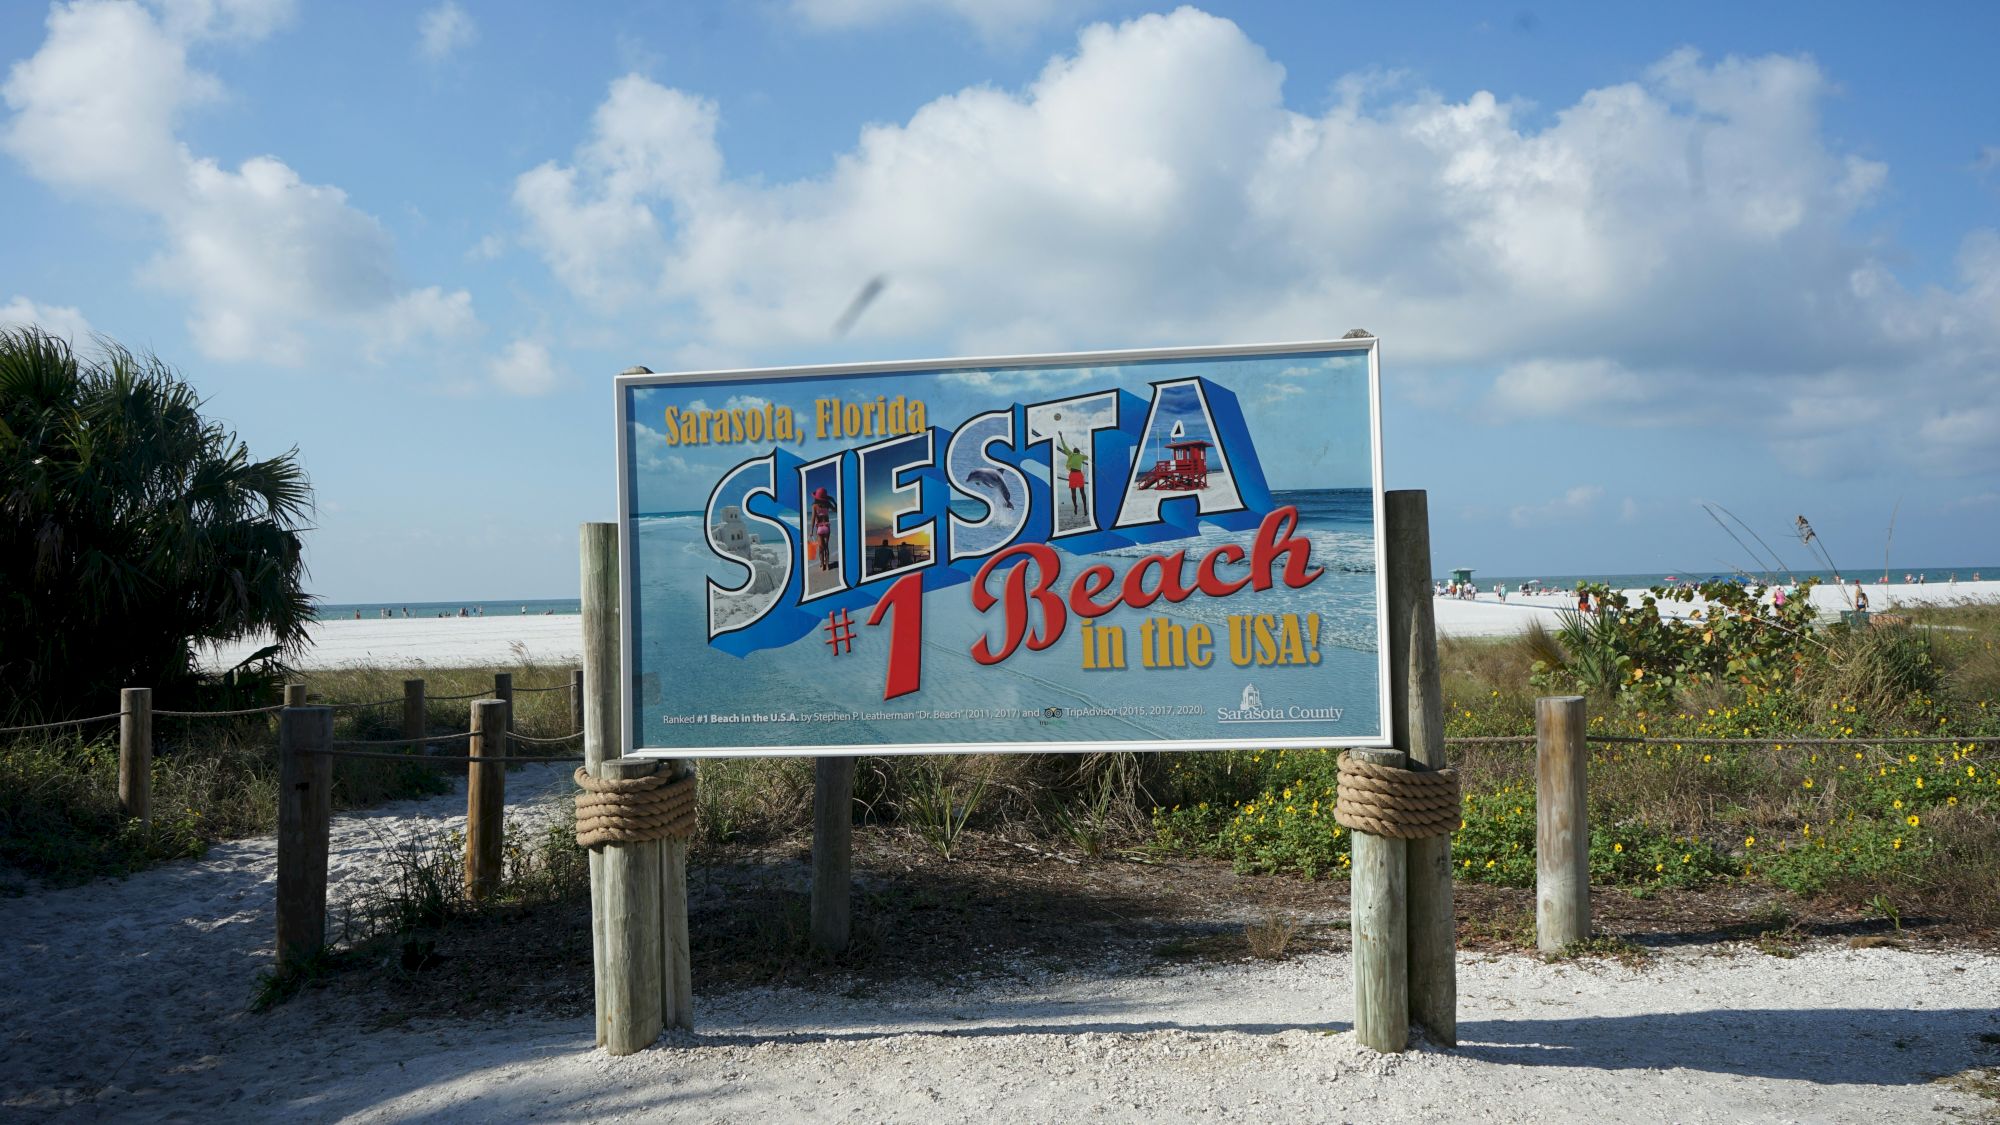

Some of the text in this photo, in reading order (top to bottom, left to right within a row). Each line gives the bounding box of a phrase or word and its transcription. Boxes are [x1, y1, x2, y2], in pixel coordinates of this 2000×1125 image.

[665, 395, 927, 446] Sarasota, Florida
[704, 376, 1248, 644] SIESTA
[824, 505, 1325, 700] #1 Beach
[1081, 612, 1323, 670] in the USA!
[663, 714, 695, 724] Ranked
[697, 714, 708, 724] #1
[710, 713, 740, 723] Beach
[741, 713, 750, 723] in
[752, 713, 769, 723] the
[770, 712, 799, 722] U.S.A.
[801, 712, 812, 724] by
[813, 711, 851, 724] Stephen
[861, 710, 915, 721] Leatherman
[965, 708, 993, 721] (2011,
[995, 708, 1021, 720] 2017)
[1022, 708, 1040, 718] and
[1065, 706, 1118, 719] TripAdvisor
[1119, 705, 1148, 718] (2015,
[1150, 705, 1174, 717] 2017,
[1177, 704, 1206, 718] 2020).
[1217, 705, 1344, 722] Sarasota County
